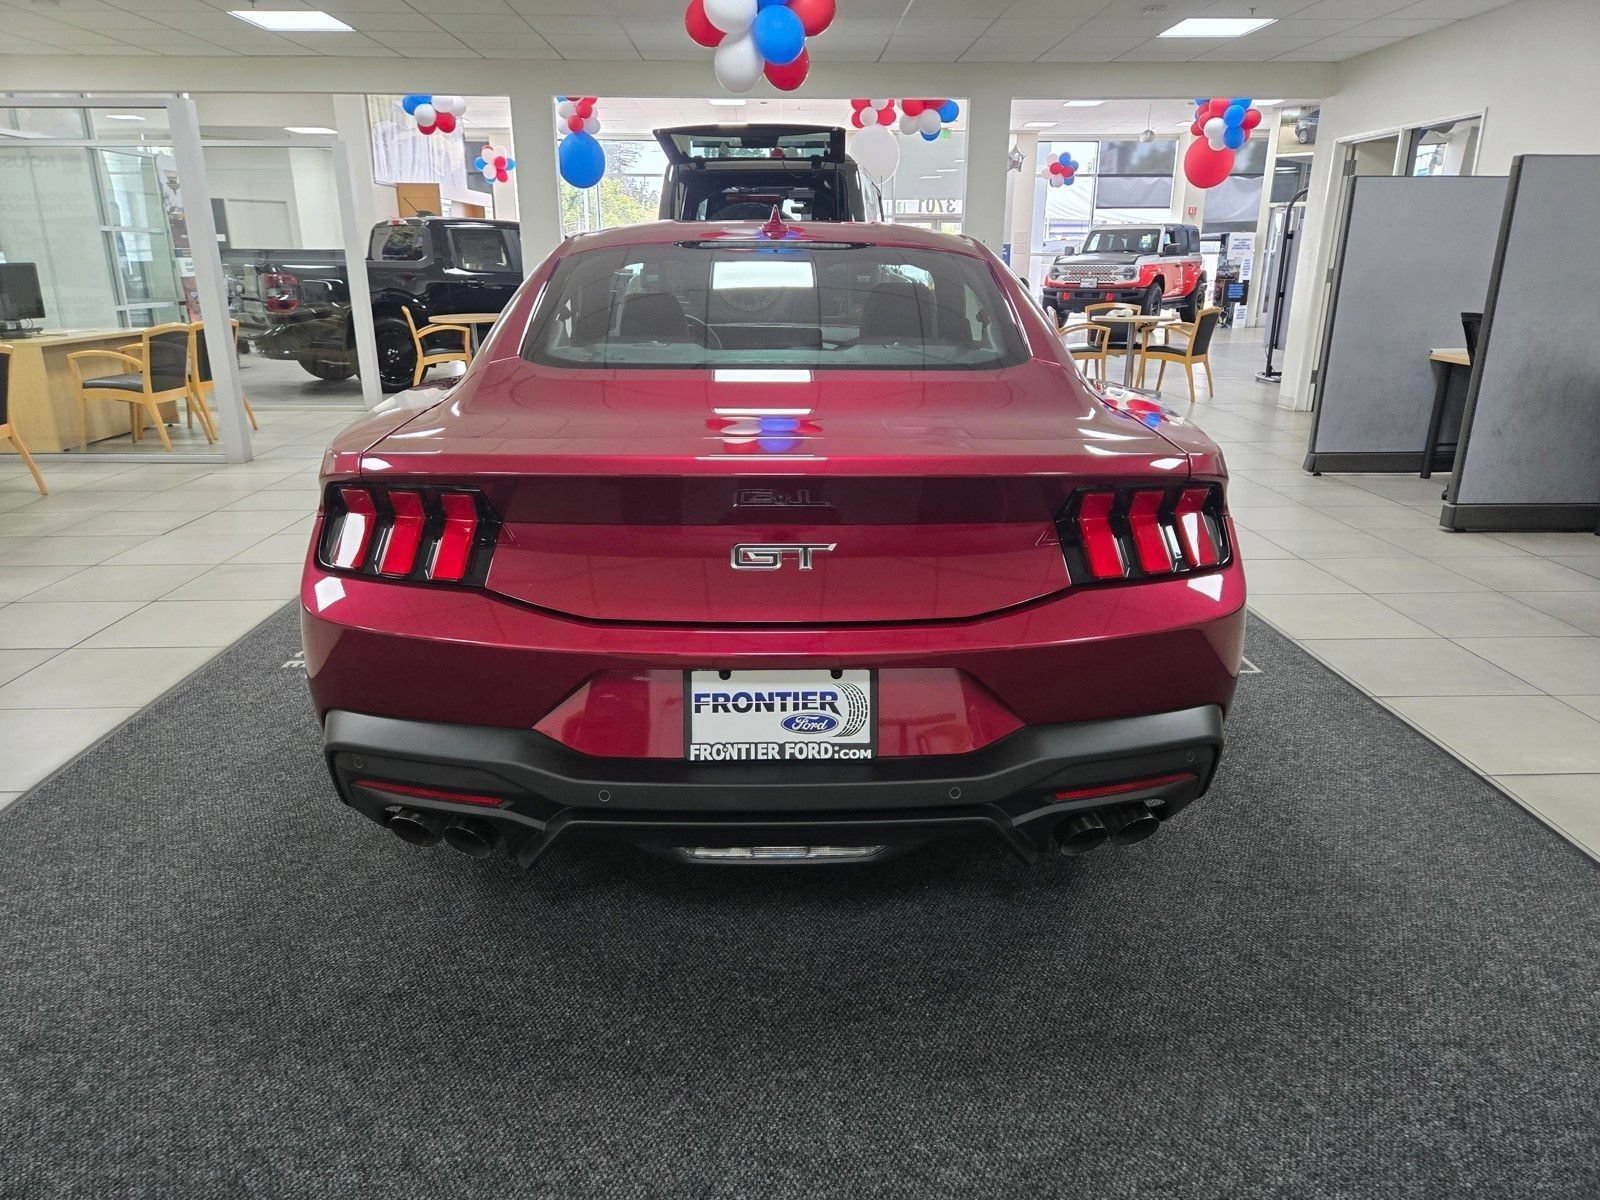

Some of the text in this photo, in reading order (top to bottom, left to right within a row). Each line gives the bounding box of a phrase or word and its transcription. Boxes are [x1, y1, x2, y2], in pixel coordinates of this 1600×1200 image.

[731, 543, 838, 570] GT
[694, 691, 843, 717] FRONTIER
[791, 714, 828, 731] Ford
[689, 743, 780, 761] FRONTIER
